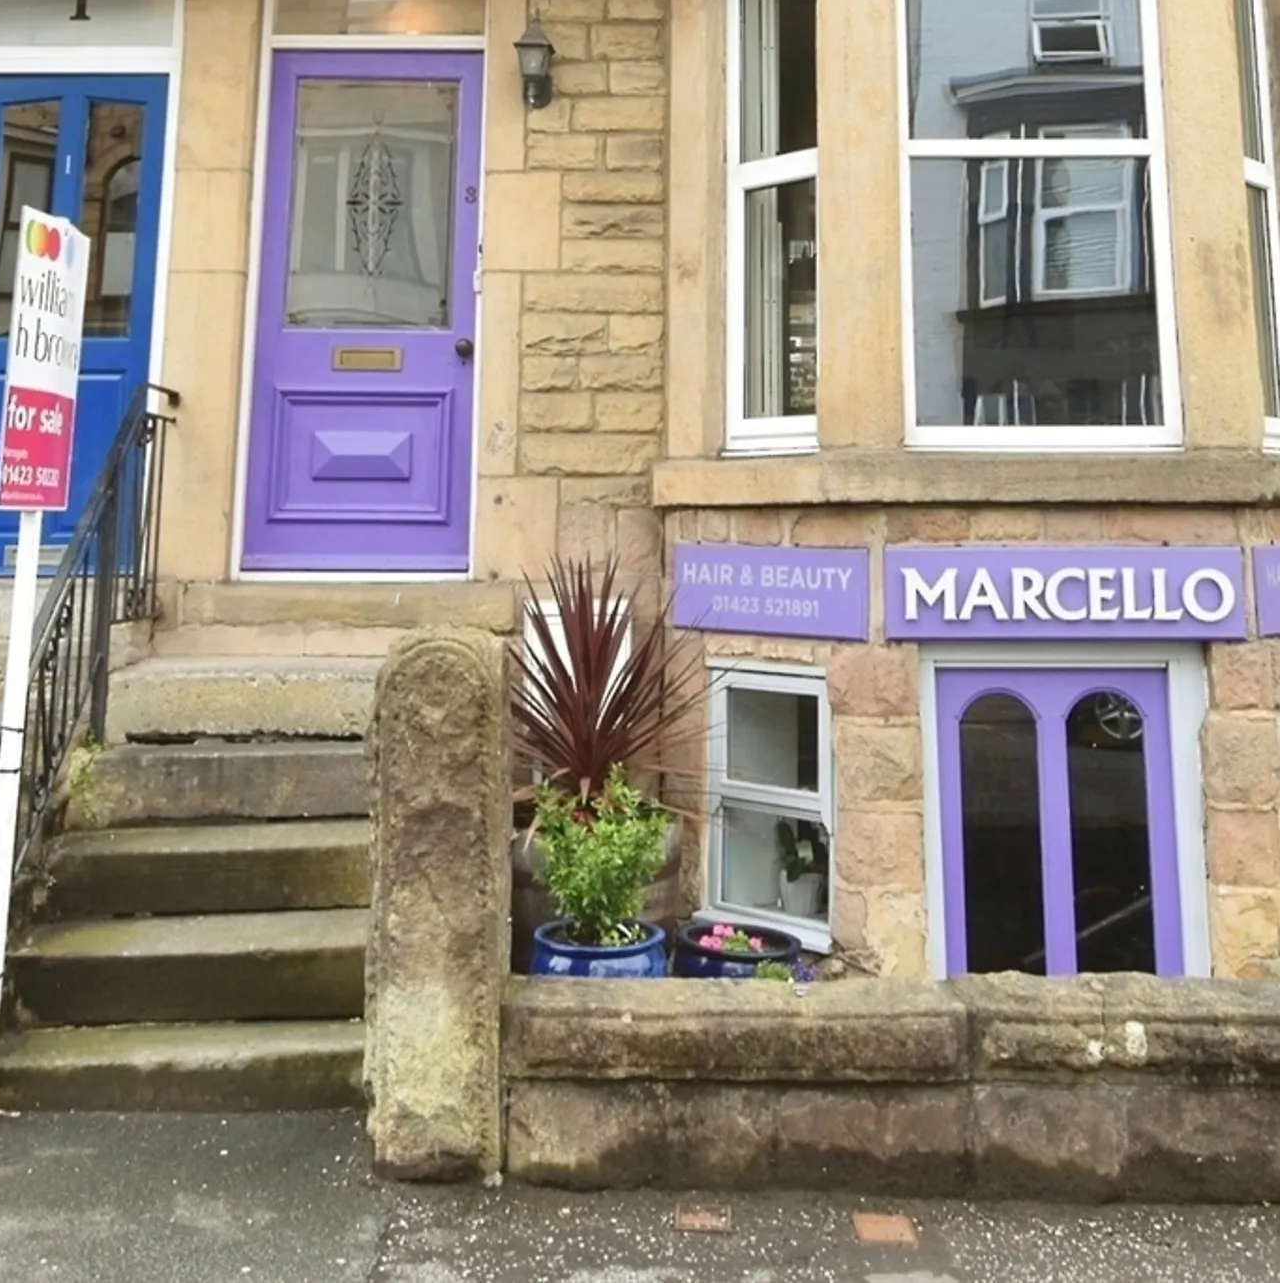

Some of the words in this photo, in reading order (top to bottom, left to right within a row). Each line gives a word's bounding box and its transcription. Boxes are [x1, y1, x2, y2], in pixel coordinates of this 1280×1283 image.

[15, 313, 29, 358] h
[8, 394, 37, 431] for
[682, 562, 734, 585] HAIR
[739, 564, 753, 586] &
[761, 565, 852, 591] BEAUTY
[900, 566, 1237, 623] MARCELLO
[712, 595, 759, 614] 01423
[764, 598, 820, 617] 521891
